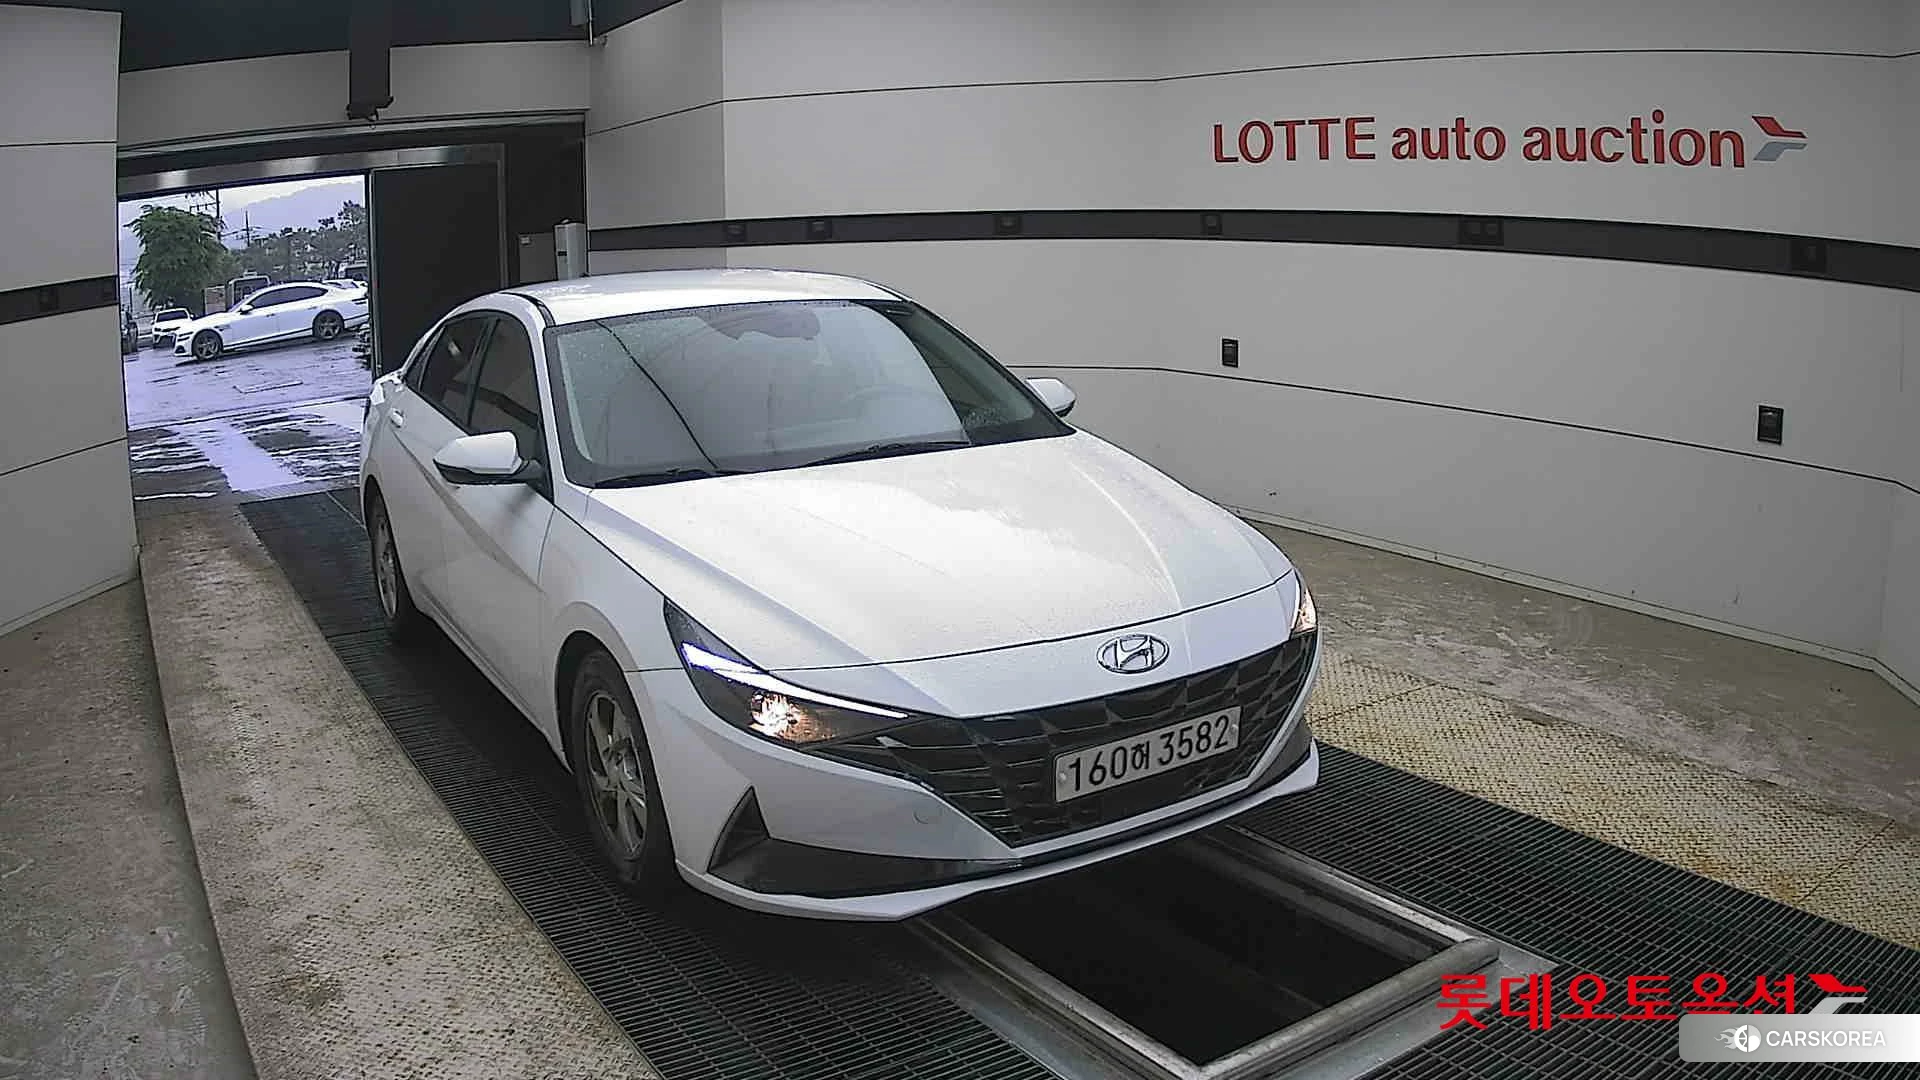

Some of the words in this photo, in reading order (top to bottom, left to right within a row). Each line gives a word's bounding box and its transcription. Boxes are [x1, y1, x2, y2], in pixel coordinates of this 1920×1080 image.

[1213, 117, 1376, 162] LOTTE
[1391, 117, 1507, 161] auto
[1522, 110, 1746, 168] auction
[1069, 741, 1150, 792] 160허
[1158, 715, 1229, 766] 3582
